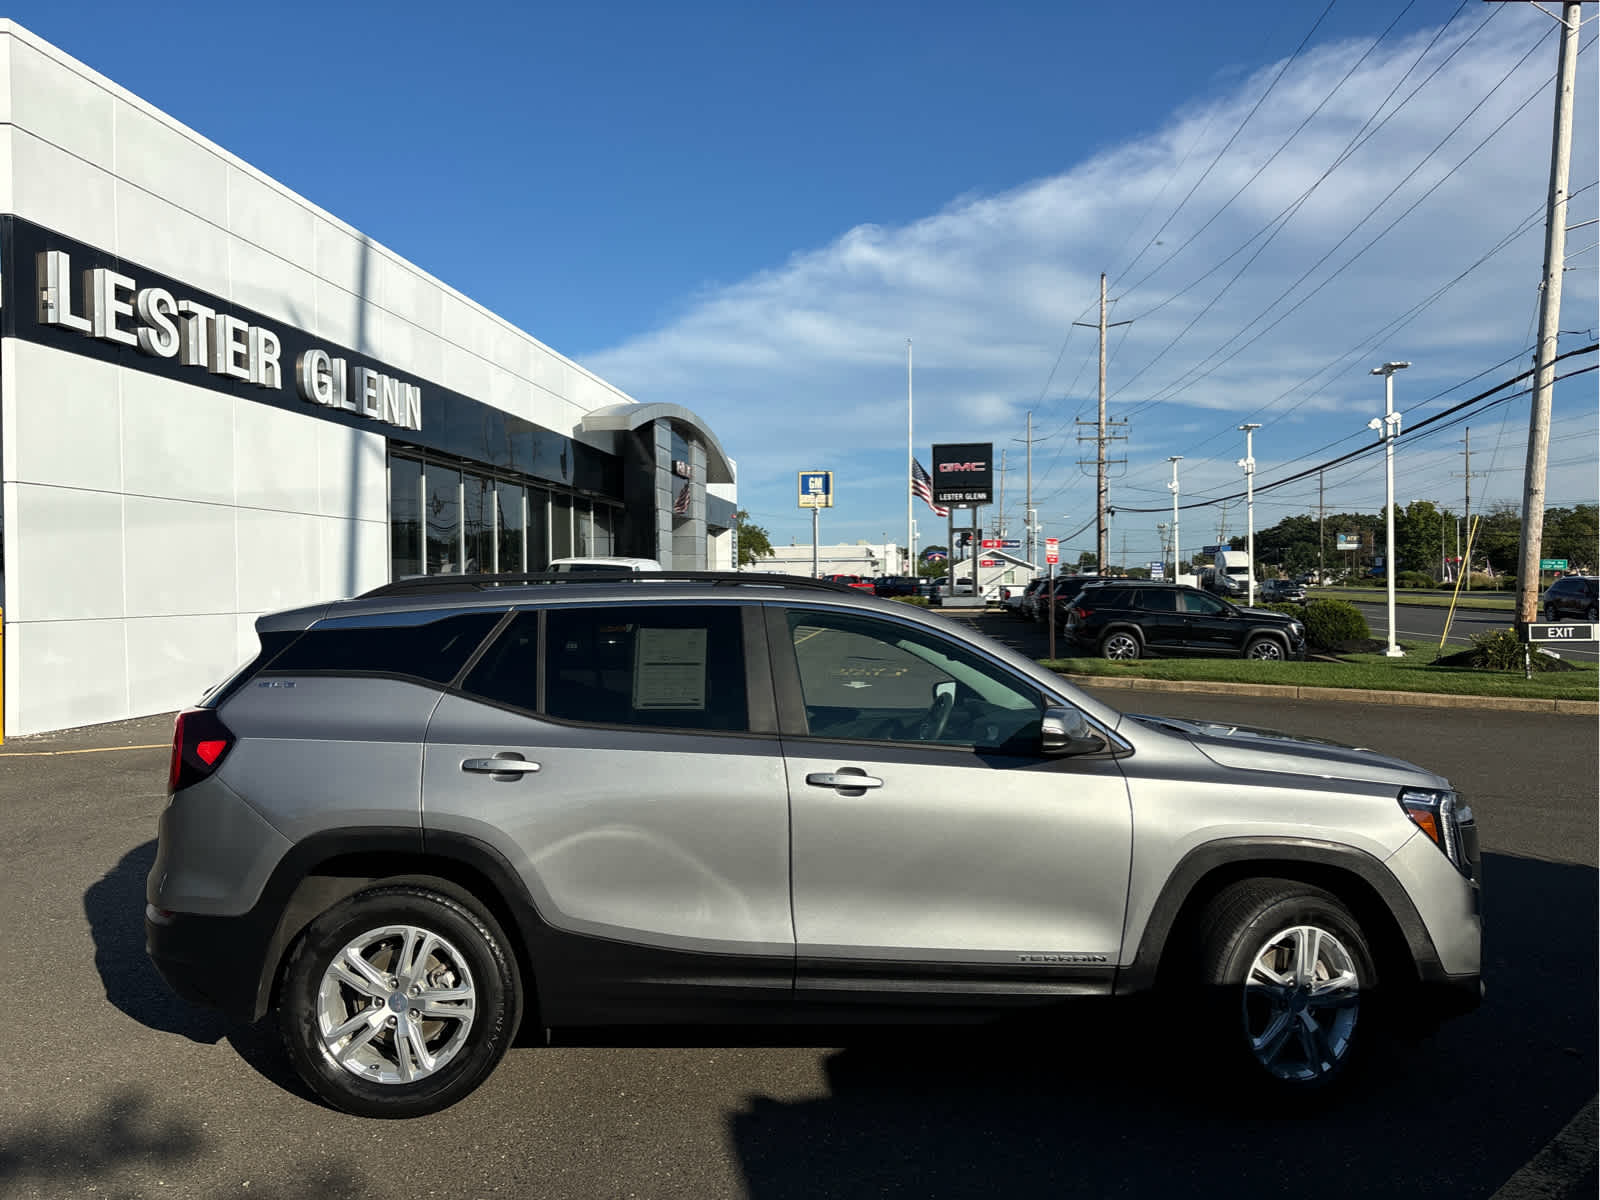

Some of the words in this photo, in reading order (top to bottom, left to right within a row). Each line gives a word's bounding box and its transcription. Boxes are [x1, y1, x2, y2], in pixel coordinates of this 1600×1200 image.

[37, 250, 282, 389] LESTER
[297, 349, 422, 431] GLENN
[939, 462, 986, 472] GMC
[808, 477, 823, 490] GM
[939, 493, 964, 501] LESTER
[964, 492, 987, 500] GLENN
[1547, 627, 1575, 638] EXIT
[1016, 953, 1107, 963] TERRAIN
